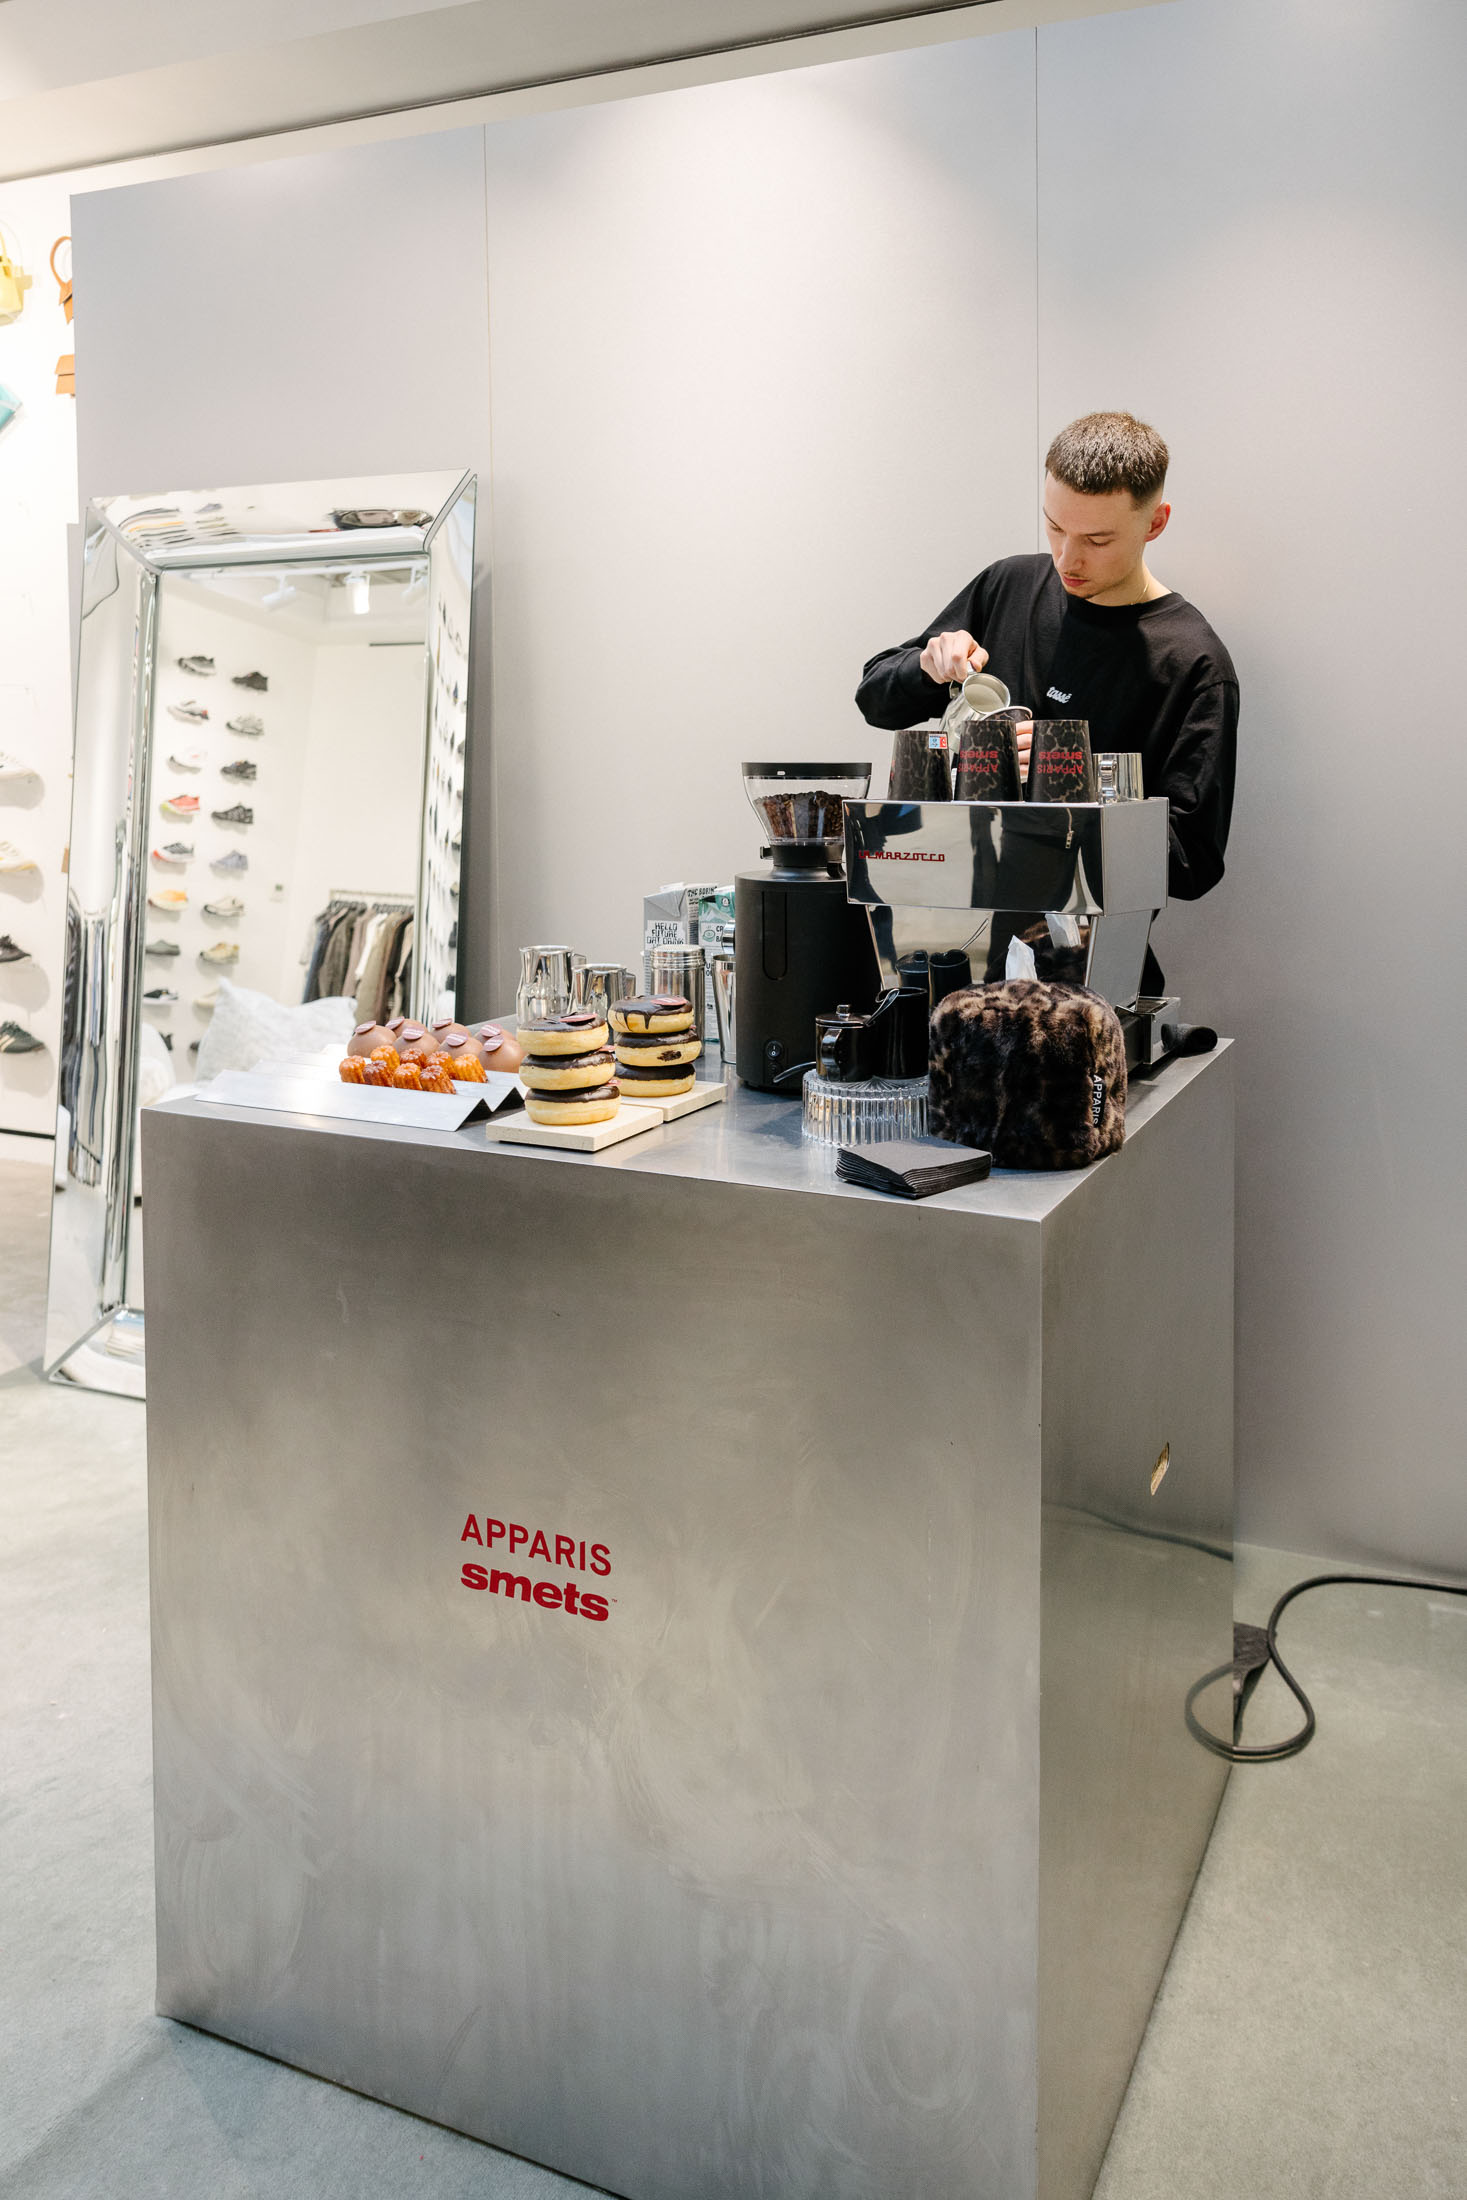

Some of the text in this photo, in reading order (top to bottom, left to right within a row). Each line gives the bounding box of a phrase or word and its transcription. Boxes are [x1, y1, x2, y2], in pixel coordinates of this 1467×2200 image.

[1038, 751, 1083, 760] smets
[1037, 763, 1084, 774] APPARIS
[873, 850, 945, 862] MARZOCCO
[655, 922, 678, 931] HELLO
[651, 929, 677, 938] FUTURE
[646, 936, 684, 945] OAT DRINK
[460, 1513, 611, 1576] APPARIS
[460, 1563, 609, 1621] smets
